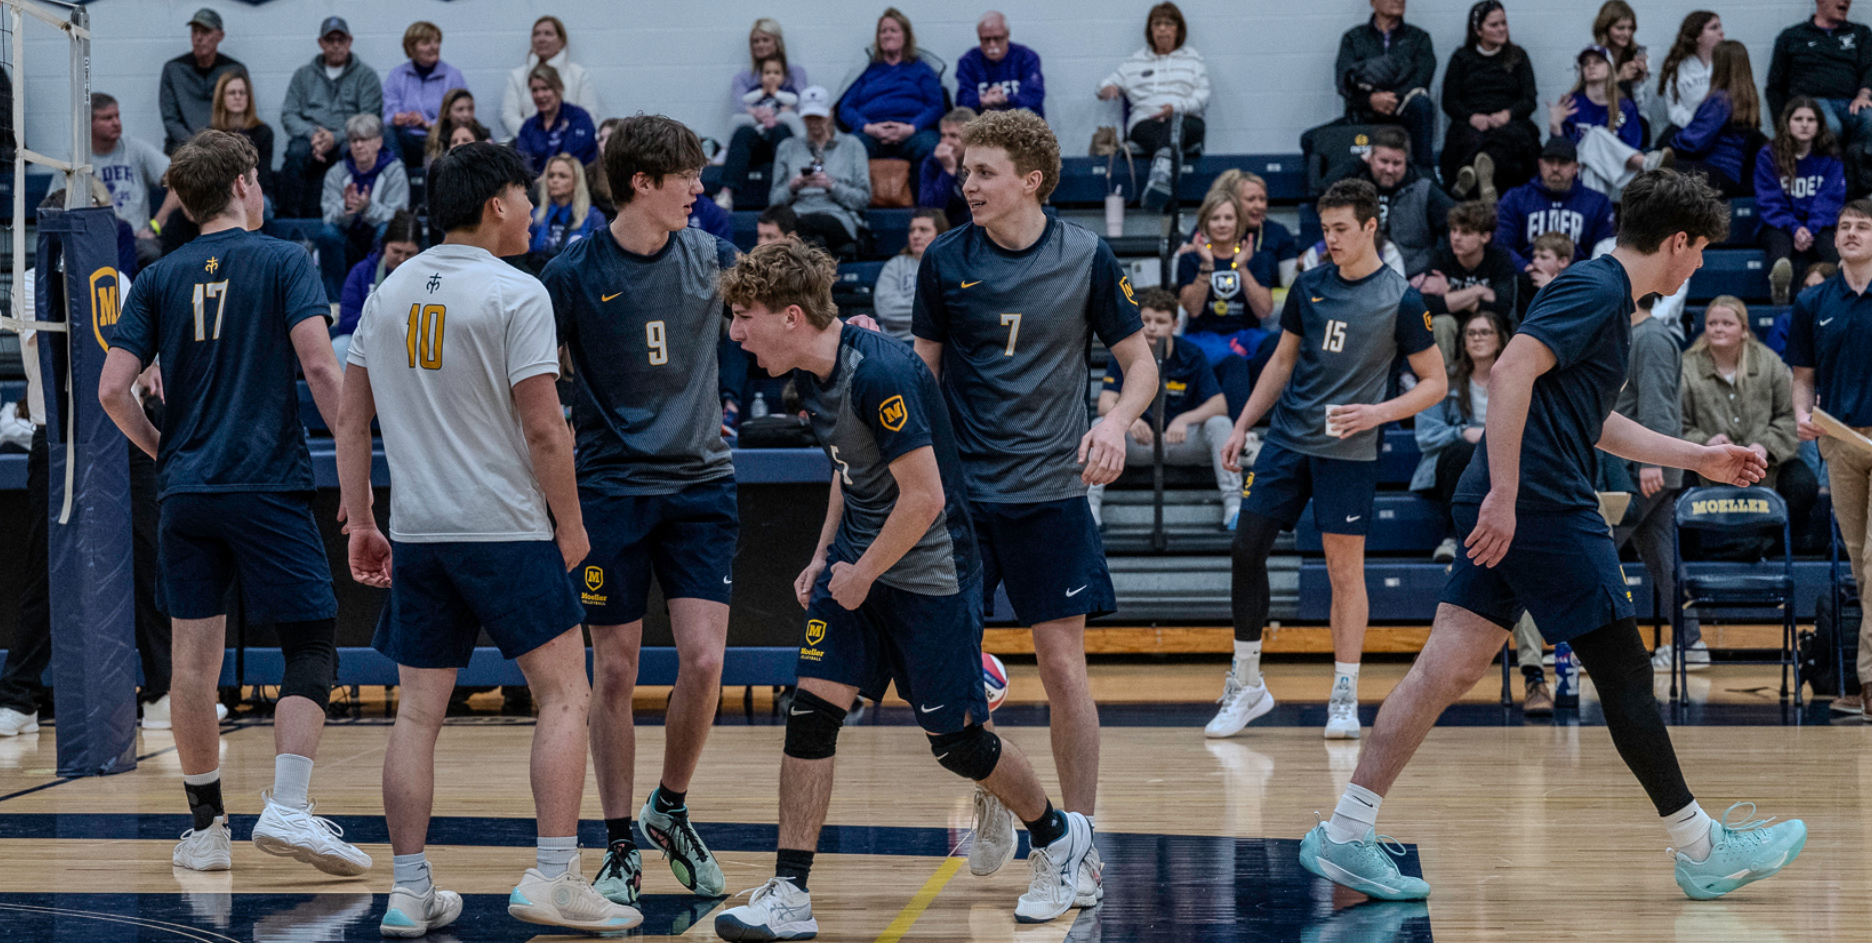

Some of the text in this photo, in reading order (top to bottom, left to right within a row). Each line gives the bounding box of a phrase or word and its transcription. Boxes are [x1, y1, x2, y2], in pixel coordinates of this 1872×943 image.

[98, 285, 117, 327] M
[191, 278, 229, 342] 17
[405, 303, 447, 370] 10
[645, 320, 669, 366] 9
[1000, 313, 1022, 361] 7
[1322, 319, 1348, 353] 15
[883, 401, 903, 423] M
[1692, 499, 1770, 515] MOELLER
[588, 571, 600, 583] M
[581, 592, 608, 602] Moeller
[808, 624, 822, 638] M
[800, 647, 825, 658] Moeller
